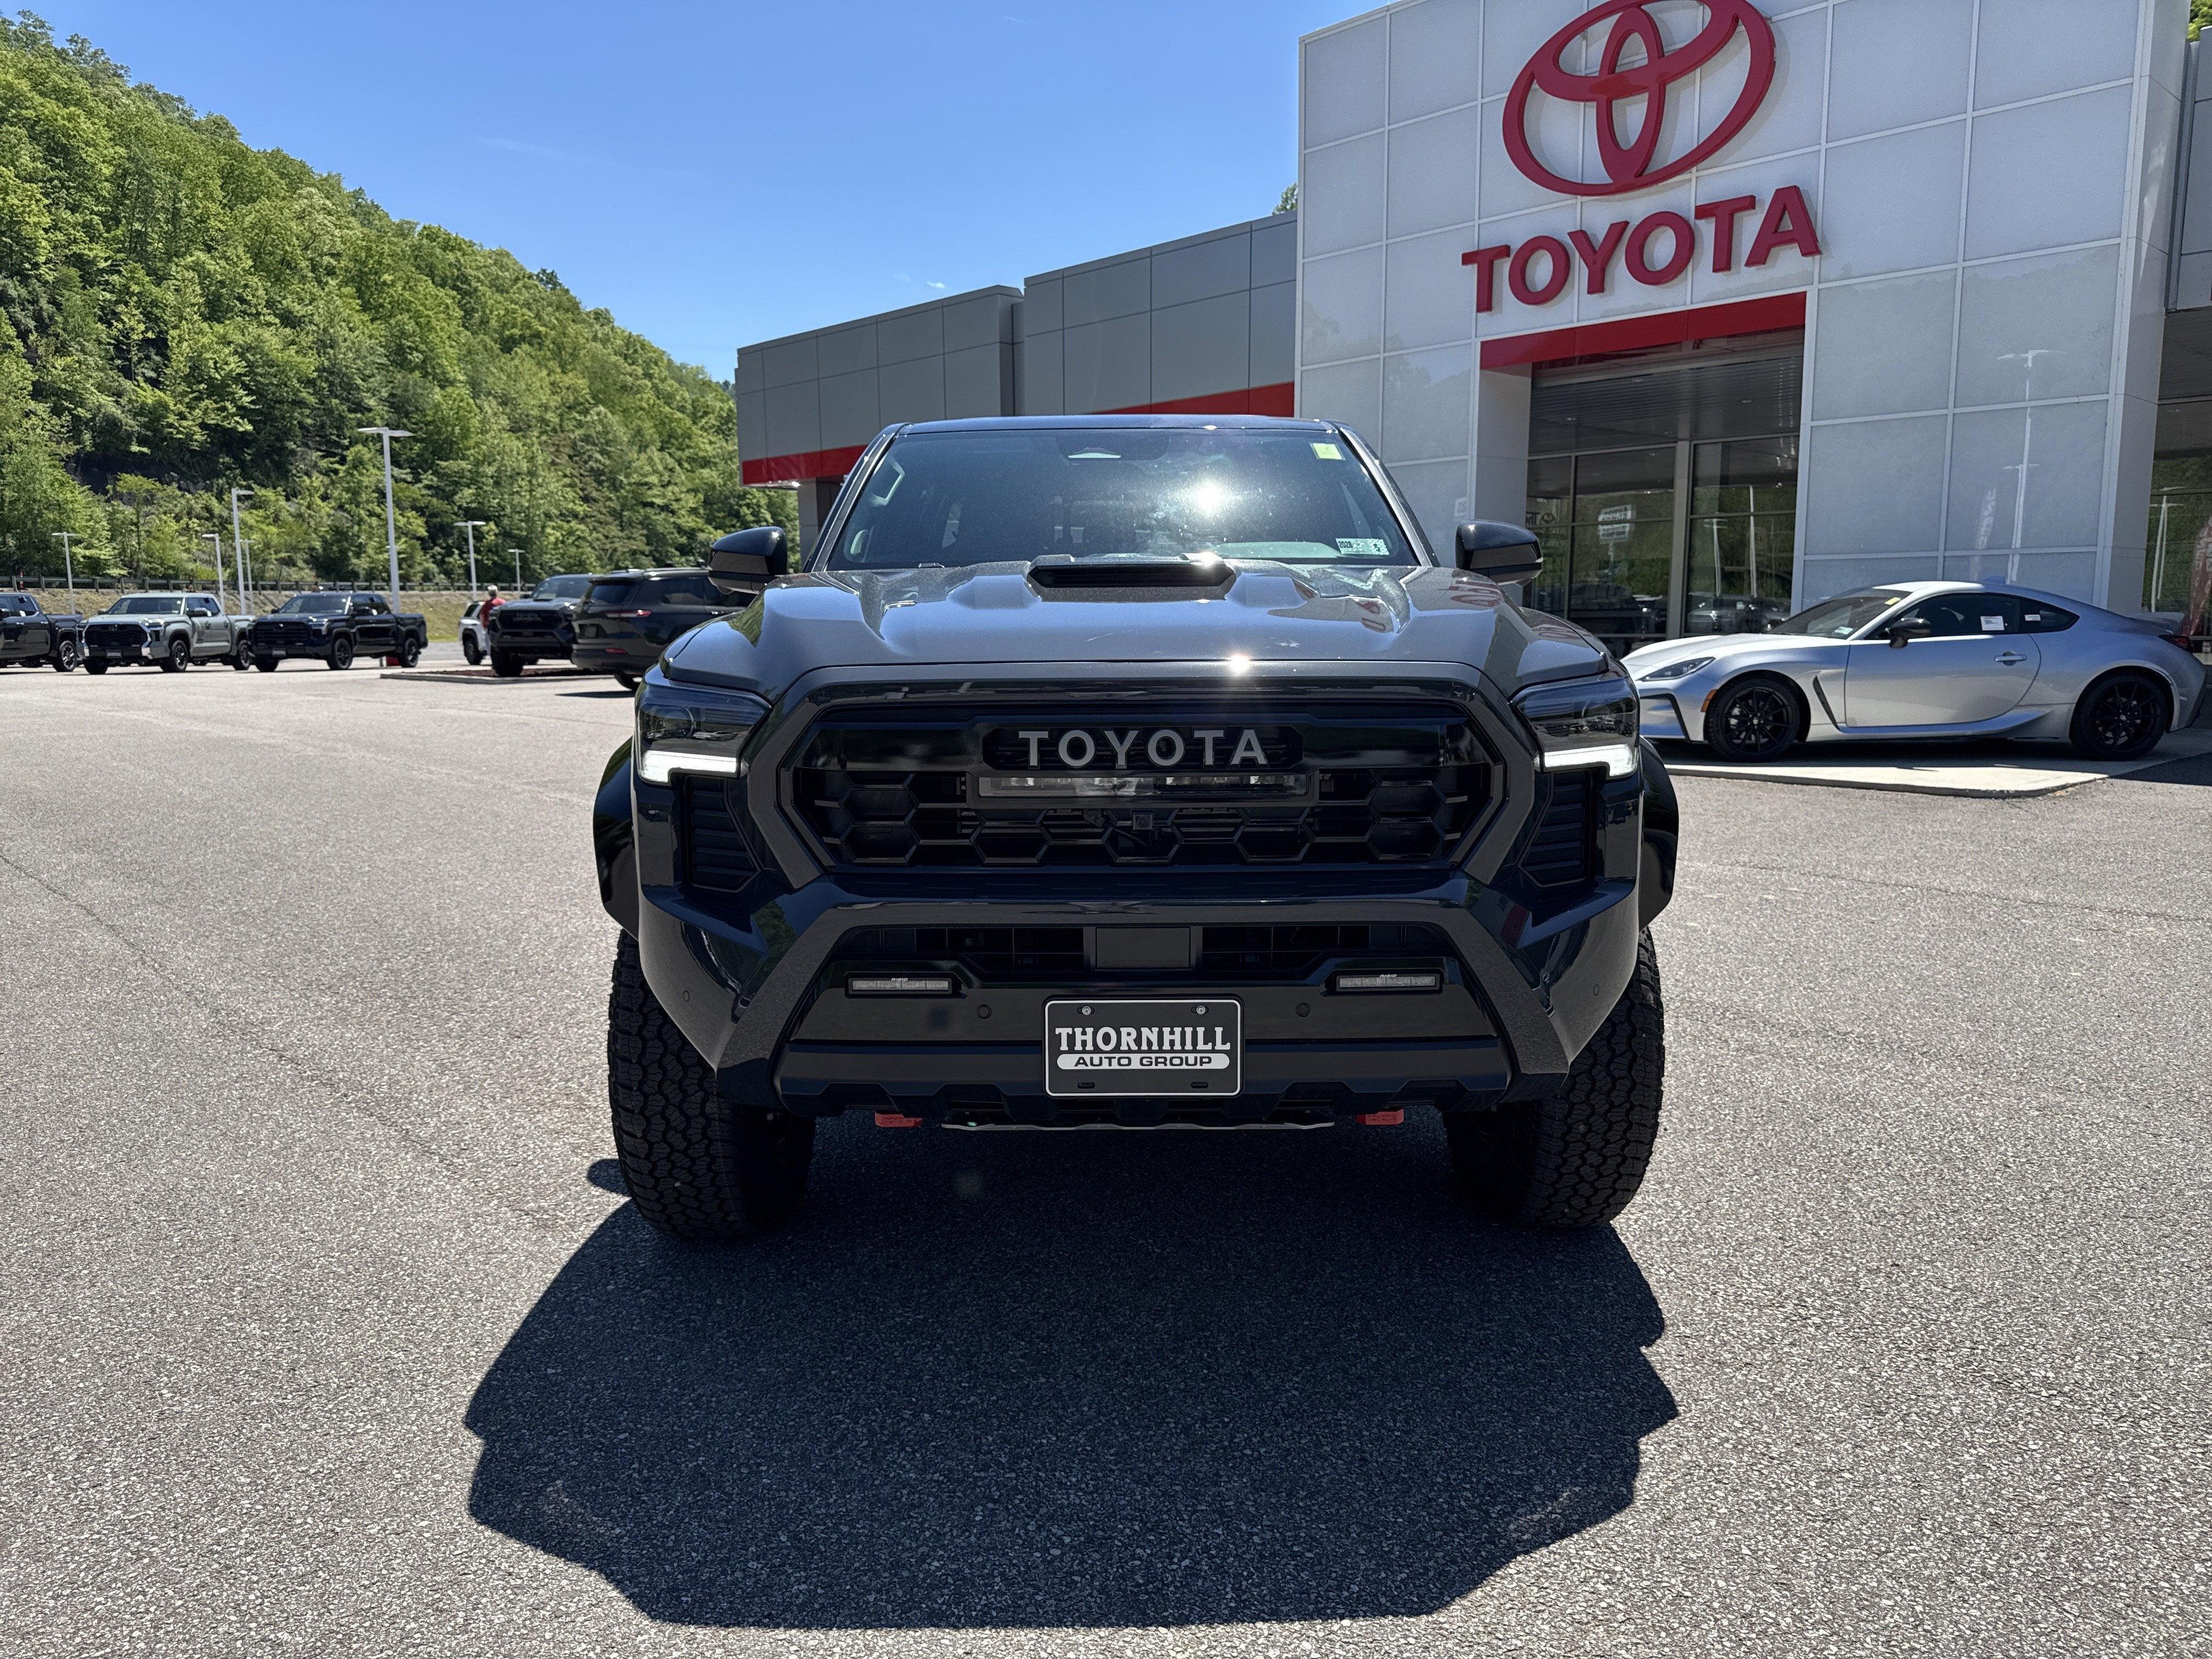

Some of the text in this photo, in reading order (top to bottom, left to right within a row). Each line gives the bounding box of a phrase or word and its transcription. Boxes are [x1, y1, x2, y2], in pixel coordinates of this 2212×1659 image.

[1462, 185, 1822, 313] TOYOTA
[1018, 729, 1269, 768] TOYOTA
[1055, 1026, 1231, 1051] THORNHILL
[1074, 1056, 1212, 1067] AUTO GROUP
